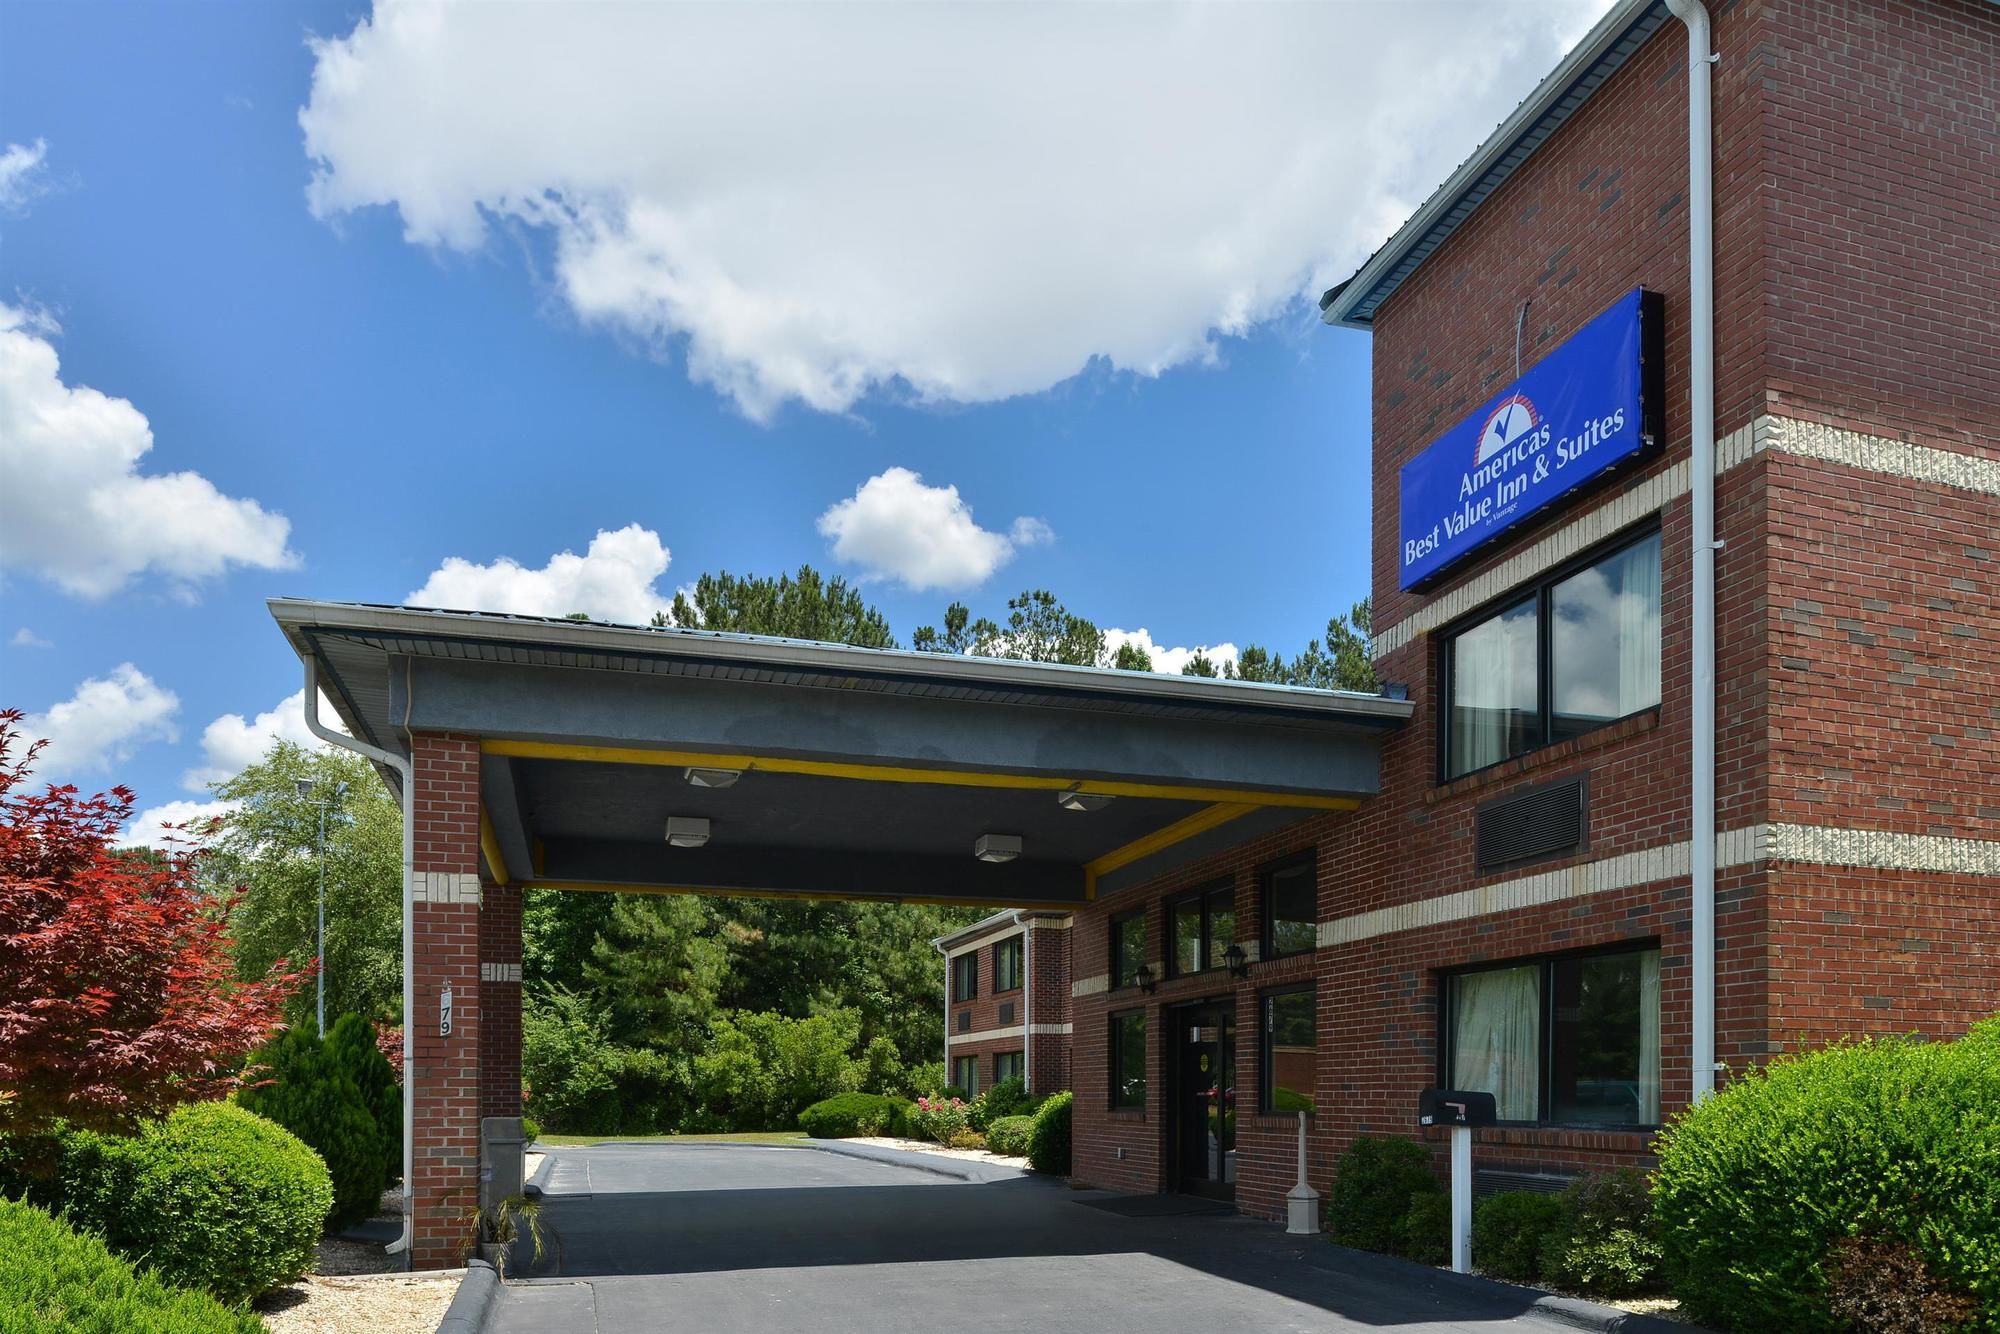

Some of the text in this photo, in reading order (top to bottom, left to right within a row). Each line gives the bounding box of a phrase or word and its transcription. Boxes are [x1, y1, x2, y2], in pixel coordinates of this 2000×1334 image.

[1405, 407, 1624, 567] Best Value Inn & Suites
[1458, 423, 1550, 502] Americas
[1493, 501, 1518, 521] Vantage
